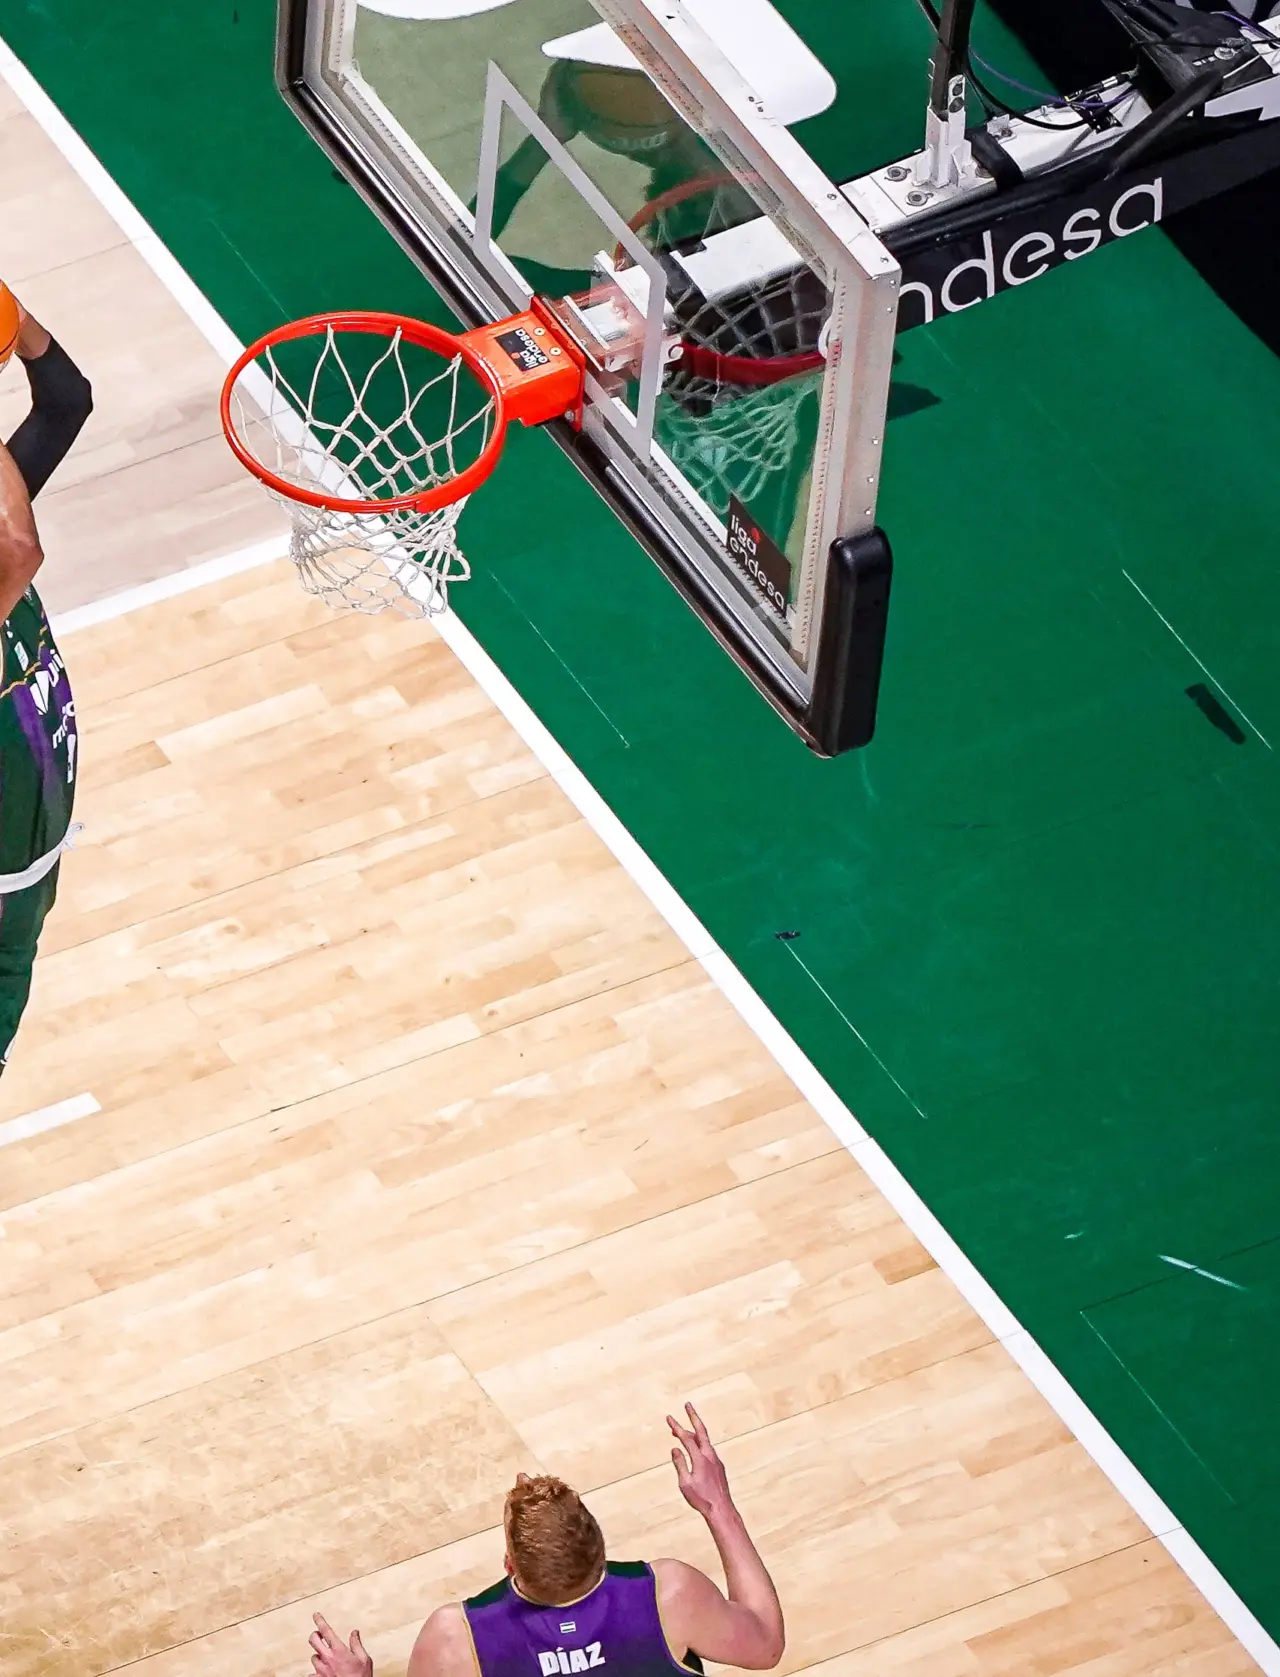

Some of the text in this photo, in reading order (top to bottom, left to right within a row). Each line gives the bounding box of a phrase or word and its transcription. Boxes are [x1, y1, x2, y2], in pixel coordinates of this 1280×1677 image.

[896, 177, 1163, 323] ndesa
[731, 515, 757, 555] liga
[730, 537, 784, 610] endesa
[537, 1641, 606, 1677] DÍAZ
